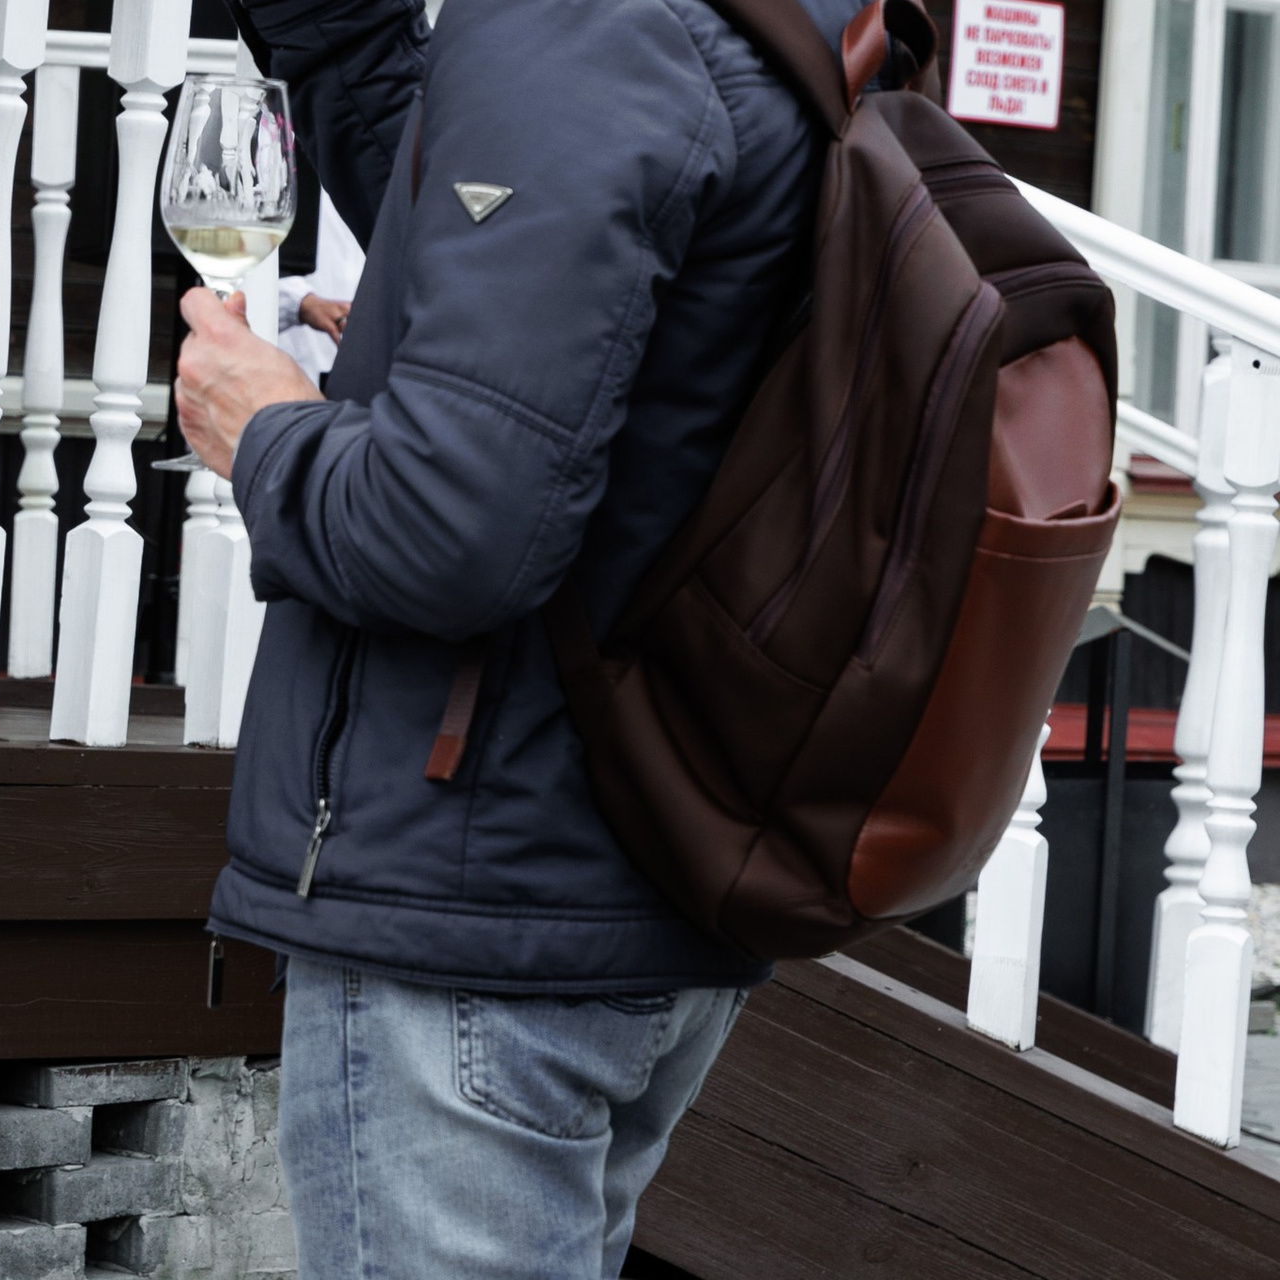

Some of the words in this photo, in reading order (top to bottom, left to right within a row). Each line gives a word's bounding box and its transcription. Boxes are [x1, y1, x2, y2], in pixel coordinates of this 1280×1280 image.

[984, 5, 1039, 26] МАШИНЫ
[965, 26, 980, 41] НЕ
[985, 27, 1051, 50] ПАРКОВАТЬ
[966, 71, 999, 90] СХОД
